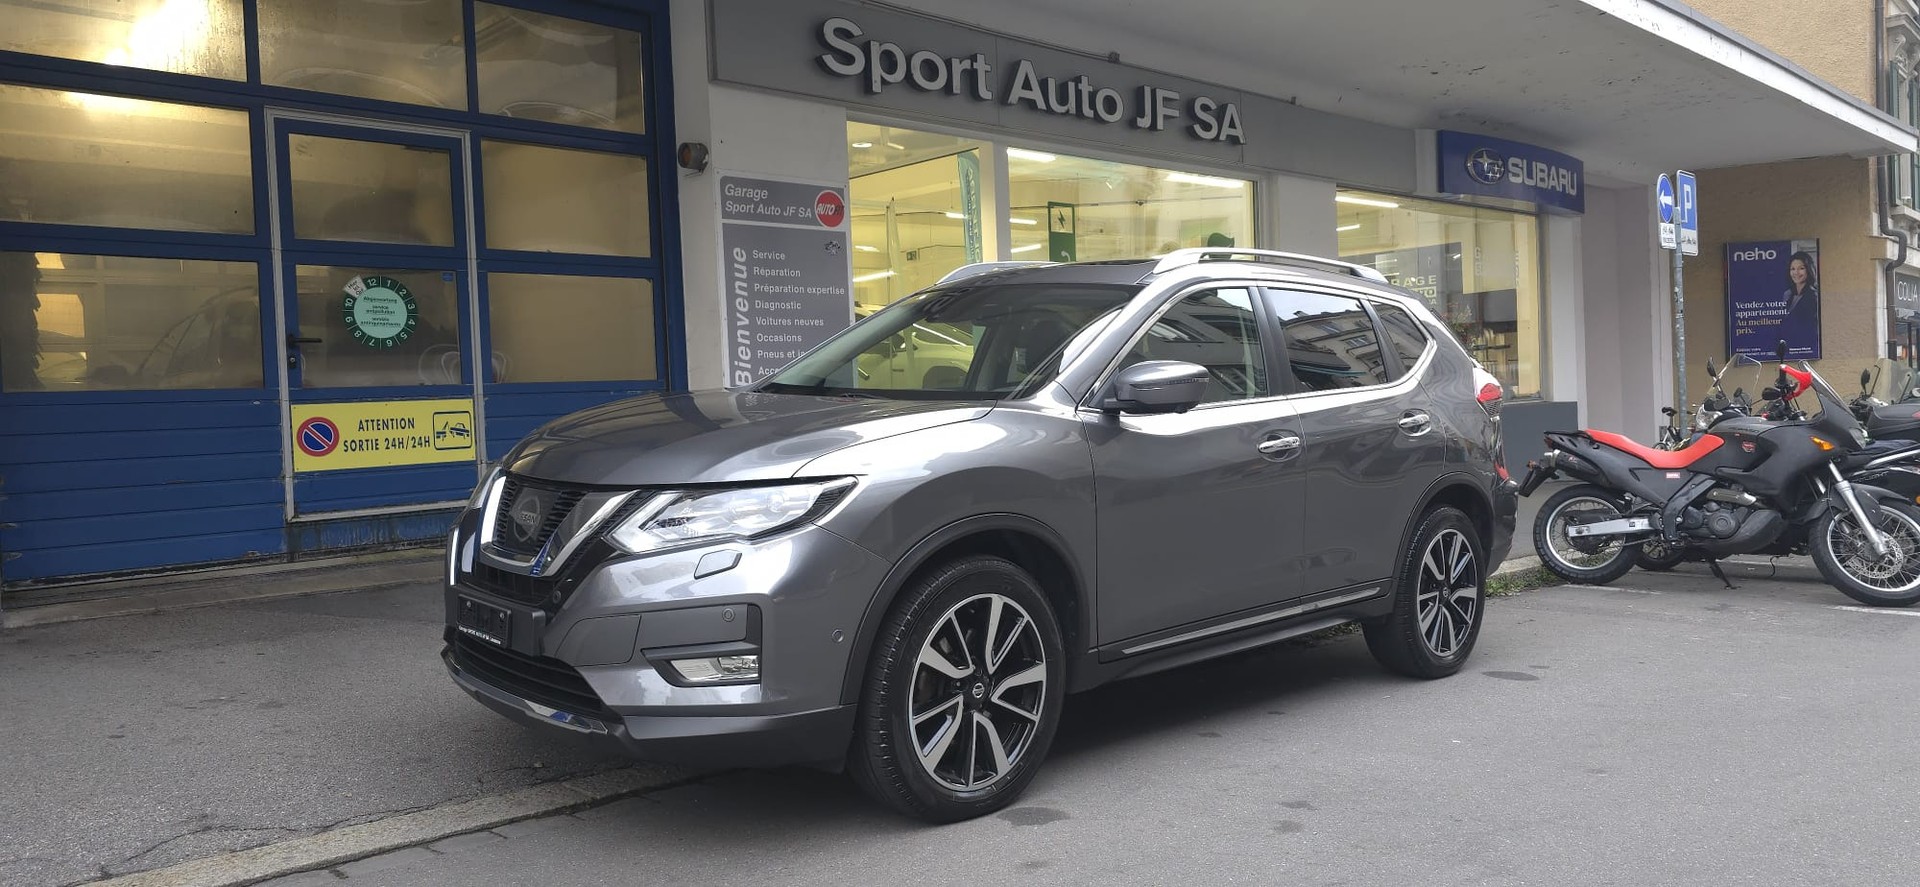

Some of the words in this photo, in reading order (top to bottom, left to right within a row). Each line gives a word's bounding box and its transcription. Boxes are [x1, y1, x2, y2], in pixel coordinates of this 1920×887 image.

[820, 16, 994, 100] Sport
[1007, 59, 1125, 123] Auto
[1136, 85, 1180, 131] JF
[1192, 96, 1246, 145] SA
[1508, 157, 1577, 196] SUBARU
[725, 184, 768, 201] Garage
[1683, 184, 1692, 222] P
[725, 201, 754, 214] Sport
[757, 204, 781, 216] Auto
[783, 206, 797, 217] JF
[798, 207, 812, 218] SA
[752, 249, 786, 260] Service
[1733, 247, 1777, 262] neho
[753, 266, 801, 278] Réparation
[367, 278, 377, 286] 12
[399, 288, 407, 297] 2
[754, 283, 805, 295] Préparation
[807, 286, 845, 296] expertise
[345, 298, 353, 307] 10
[755, 300, 802, 311] Diagnostic
[1735, 301, 1764, 309] Vendez
[1765, 300, 1787, 308] votre
[733, 247, 752, 387] Bienvenue
[1735, 308, 1790, 319] appartement.
[756, 316, 792, 326] Voitures
[794, 318, 825, 327] neuves
[1748, 318, 1783, 326] meilleur
[354, 330, 362, 338] 8
[400, 331, 408, 340] 5
[1736, 327, 1756, 336] prix.
[368, 338, 375, 346] 7
[756, 333, 802, 342] Occasions
[757, 350, 785, 359] Pneus
[787, 350, 796, 358] et
[358, 417, 415, 432] ATTENTION
[343, 438, 379, 452] SORTIE
[384, 435, 431, 450] 24H/24H
